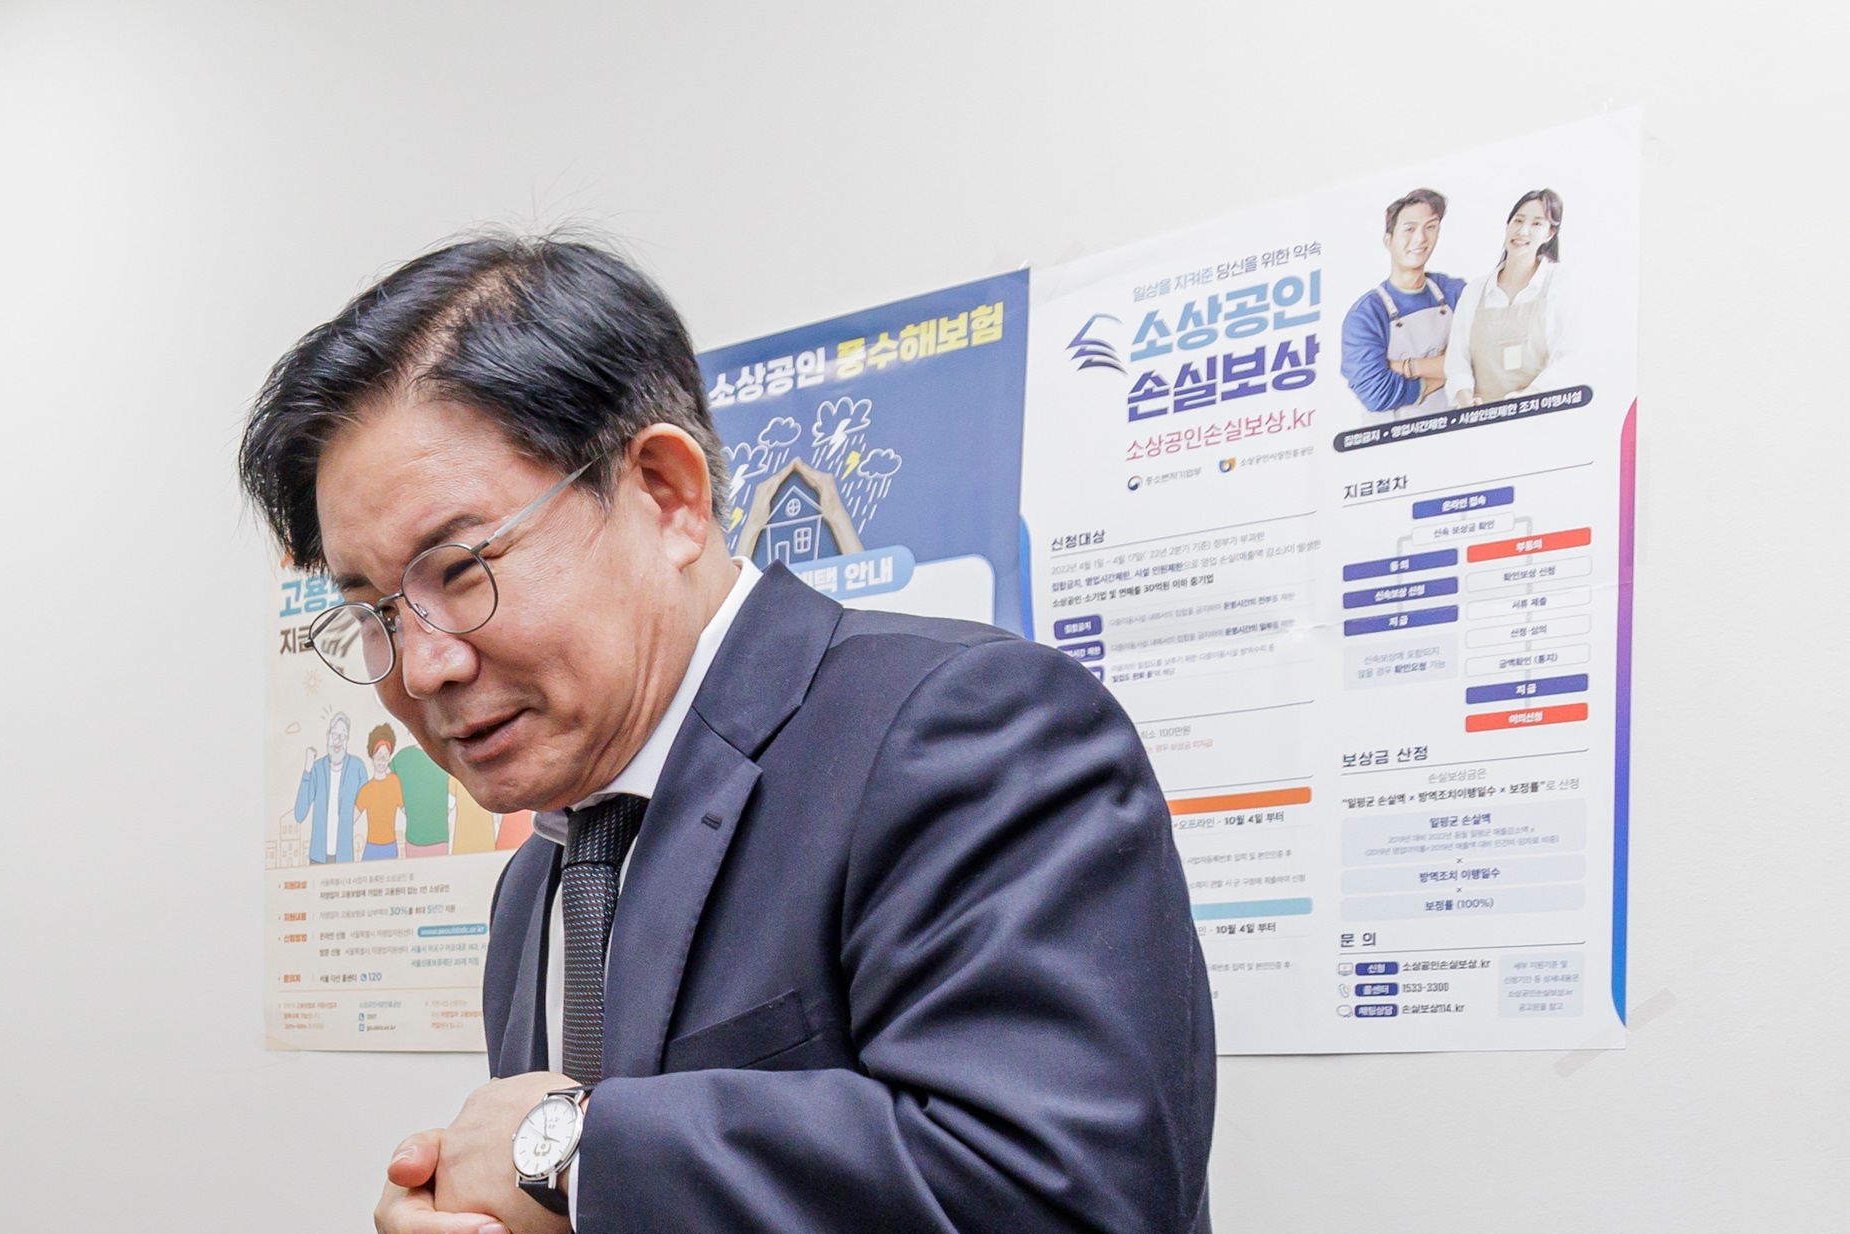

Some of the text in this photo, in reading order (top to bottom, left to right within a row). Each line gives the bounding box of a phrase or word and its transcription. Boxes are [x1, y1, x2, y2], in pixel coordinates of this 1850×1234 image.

[1133, 277, 1173, 303] 일상을
[1216, 255, 1258, 281] 당신을
[1261, 247, 1291, 270] 위한
[1293, 239, 1323, 261] 약속
[1130, 268, 1322, 363] 소상공인
[709, 301, 1004, 409] 소상공인 풍수해보험
[1127, 333, 1321, 424] 손실보상
[1125, 408, 1317, 462] 소상공인손실보상.kr
[1051, 529, 1106, 552] 신청대상
[844, 556, 894, 591] 안내
[1159, 725, 1191, 738] 100만원
[1342, 745, 1429, 769] 보상금 산정
[1377, 792, 1407, 807] 손실액
[1558, 777, 1580, 791] 산정
[1178, 811, 1285, 830] 오프라인 10월 4일 부터
[1429, 813, 1492, 828] 일평균 손실액
[1419, 867, 1501, 883] 방역조치 이행일수
[1425, 897, 1494, 912] 보정률 (100%)
[1215, 921, 1277, 935] 10월 4일 부터
[368, 972, 382, 981] 120
[1402, 981, 1450, 993] 1533-3300
